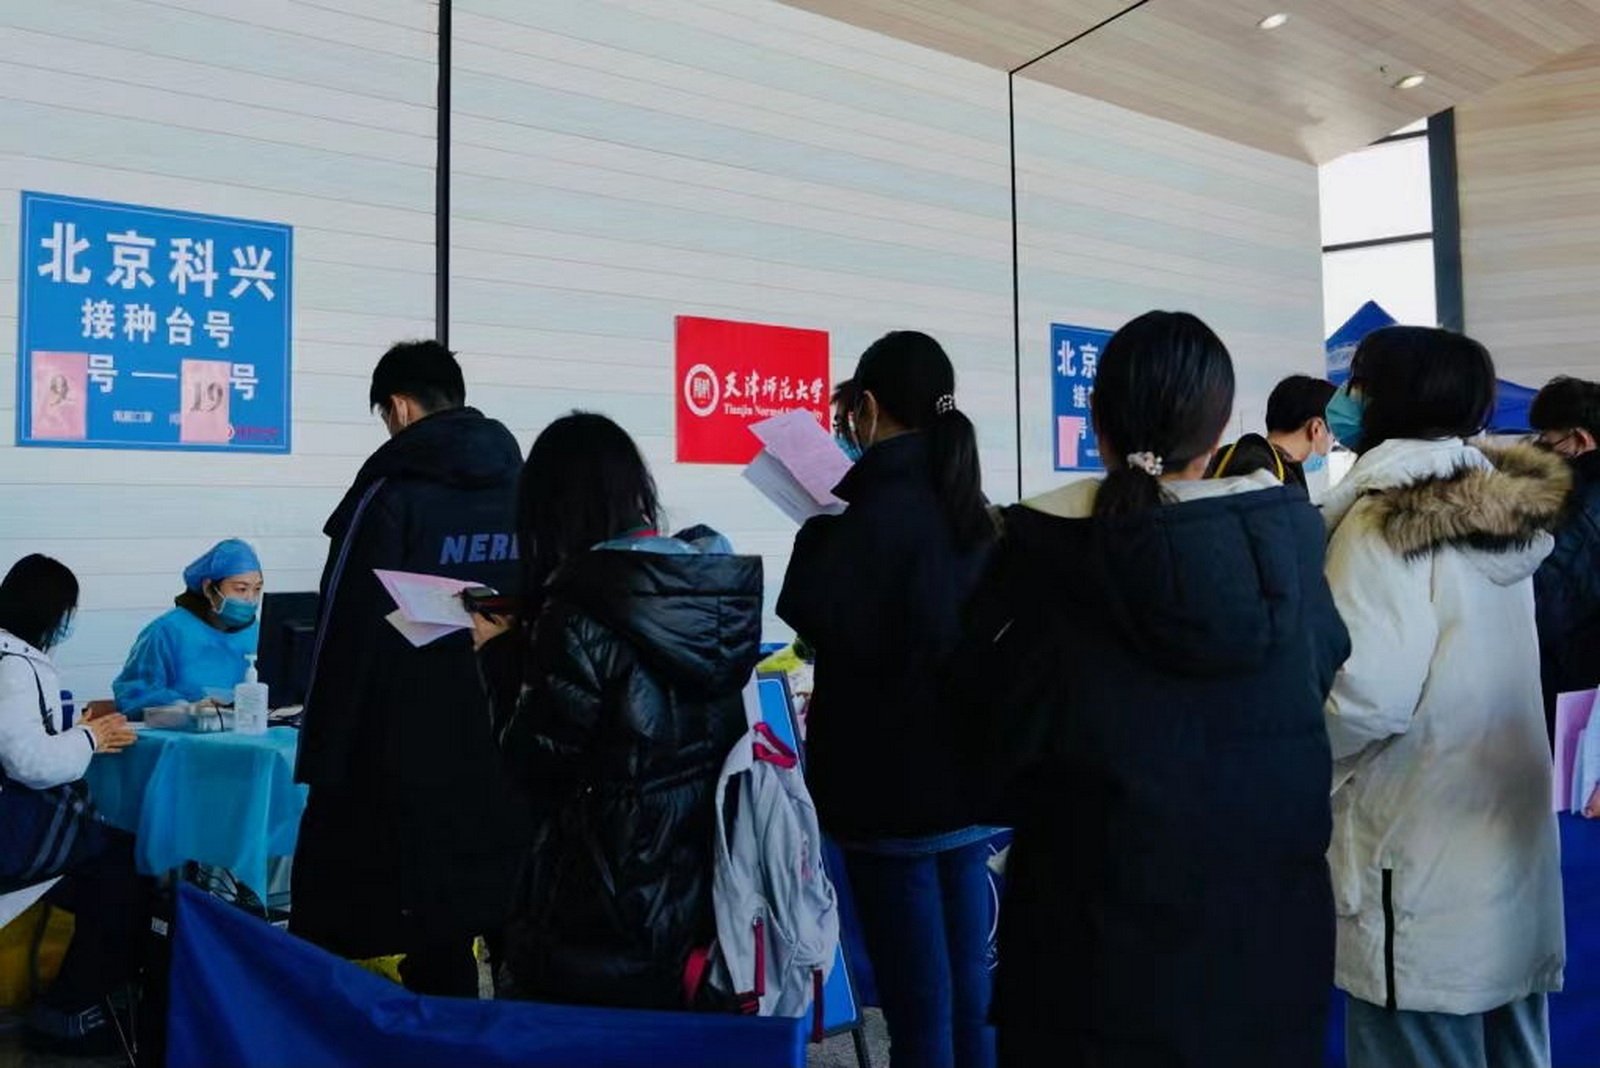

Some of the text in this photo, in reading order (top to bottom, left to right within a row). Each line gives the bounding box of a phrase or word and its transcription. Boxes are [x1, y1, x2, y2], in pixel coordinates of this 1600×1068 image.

[38, 222, 276, 301] 北京科兴
[81, 299, 234, 348] 接种台号
[1057, 340, 1099, 379] 北京
[723, 369, 824, 404] 天津师范大学
[724, 403, 753, 418] Tianjin
